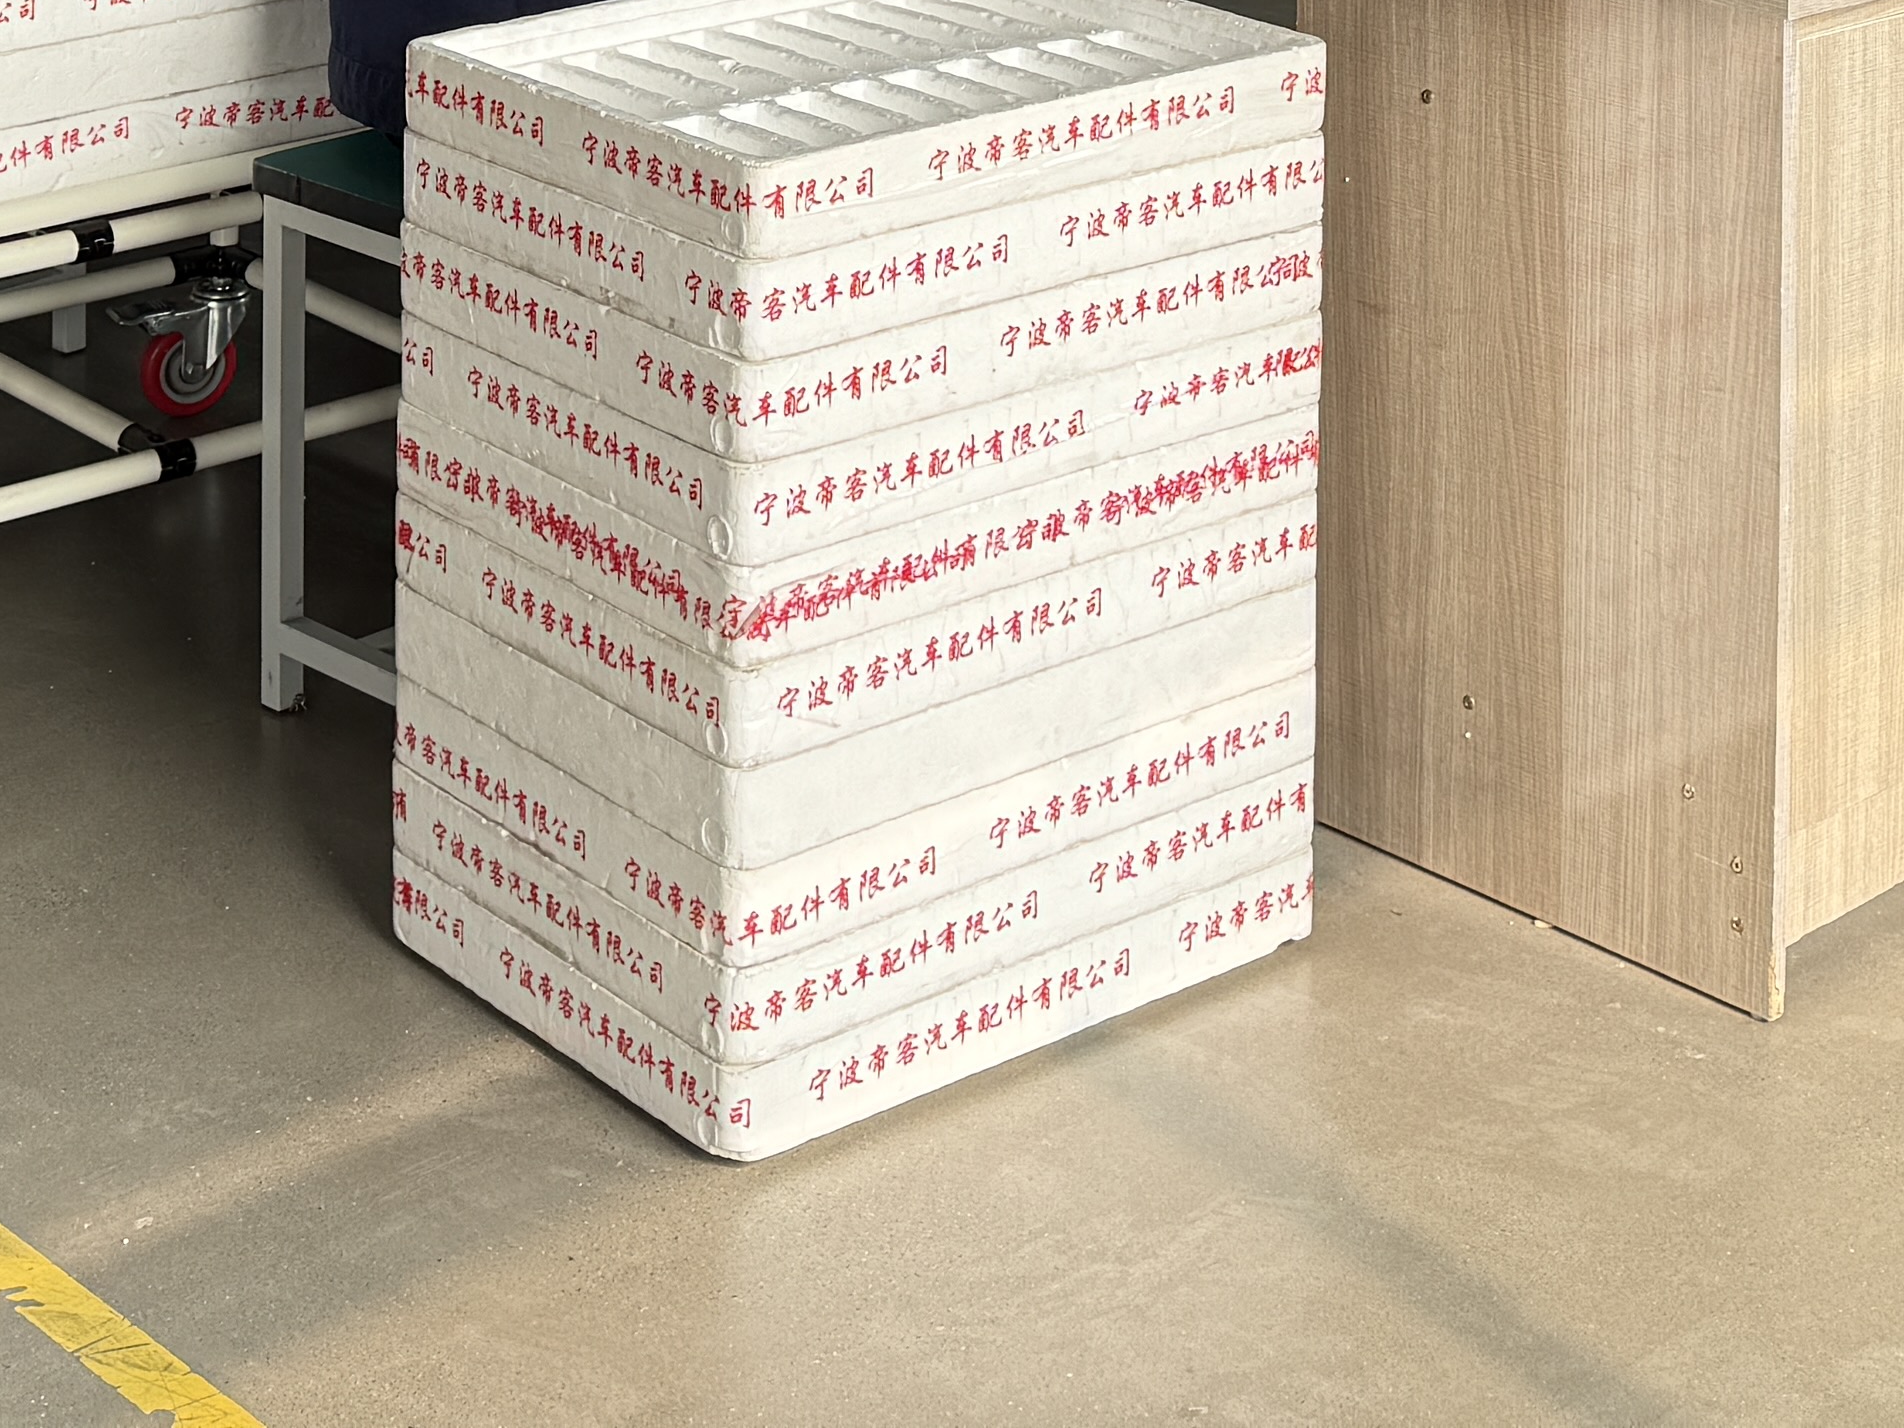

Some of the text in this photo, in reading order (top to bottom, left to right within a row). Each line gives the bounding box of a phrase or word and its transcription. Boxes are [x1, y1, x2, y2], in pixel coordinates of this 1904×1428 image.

[408, 71, 545, 147] 车配件有限公司
[928, 85, 1235, 181] 宁波帝客汽车配件有限公司
[417, 159, 646, 282] 宁波帝客汽车配件有限公司
[467, 366, 704, 511] 宁波帝客汽车配件有限公司
[754, 410, 1085, 529] 宁波帝客汽车配件有限公司
[481, 566, 722, 728] 宁波帝客汽车配件有限公司
[777, 588, 1104, 718] 宁波帝客汽车配件有限公司
[990, 711, 1291, 849] 宁波帝客汽车配件有限公司
[432, 819, 664, 993] 宁波帝客汽车配件有限公司
[704, 890, 1039, 1033] 宁波帝客汽车配件有限公司
[499, 946, 752, 1130] 宁波帝客汽车配件有限公司
[809, 948, 1132, 1102] 宁波帝客汽车配件有限公司
